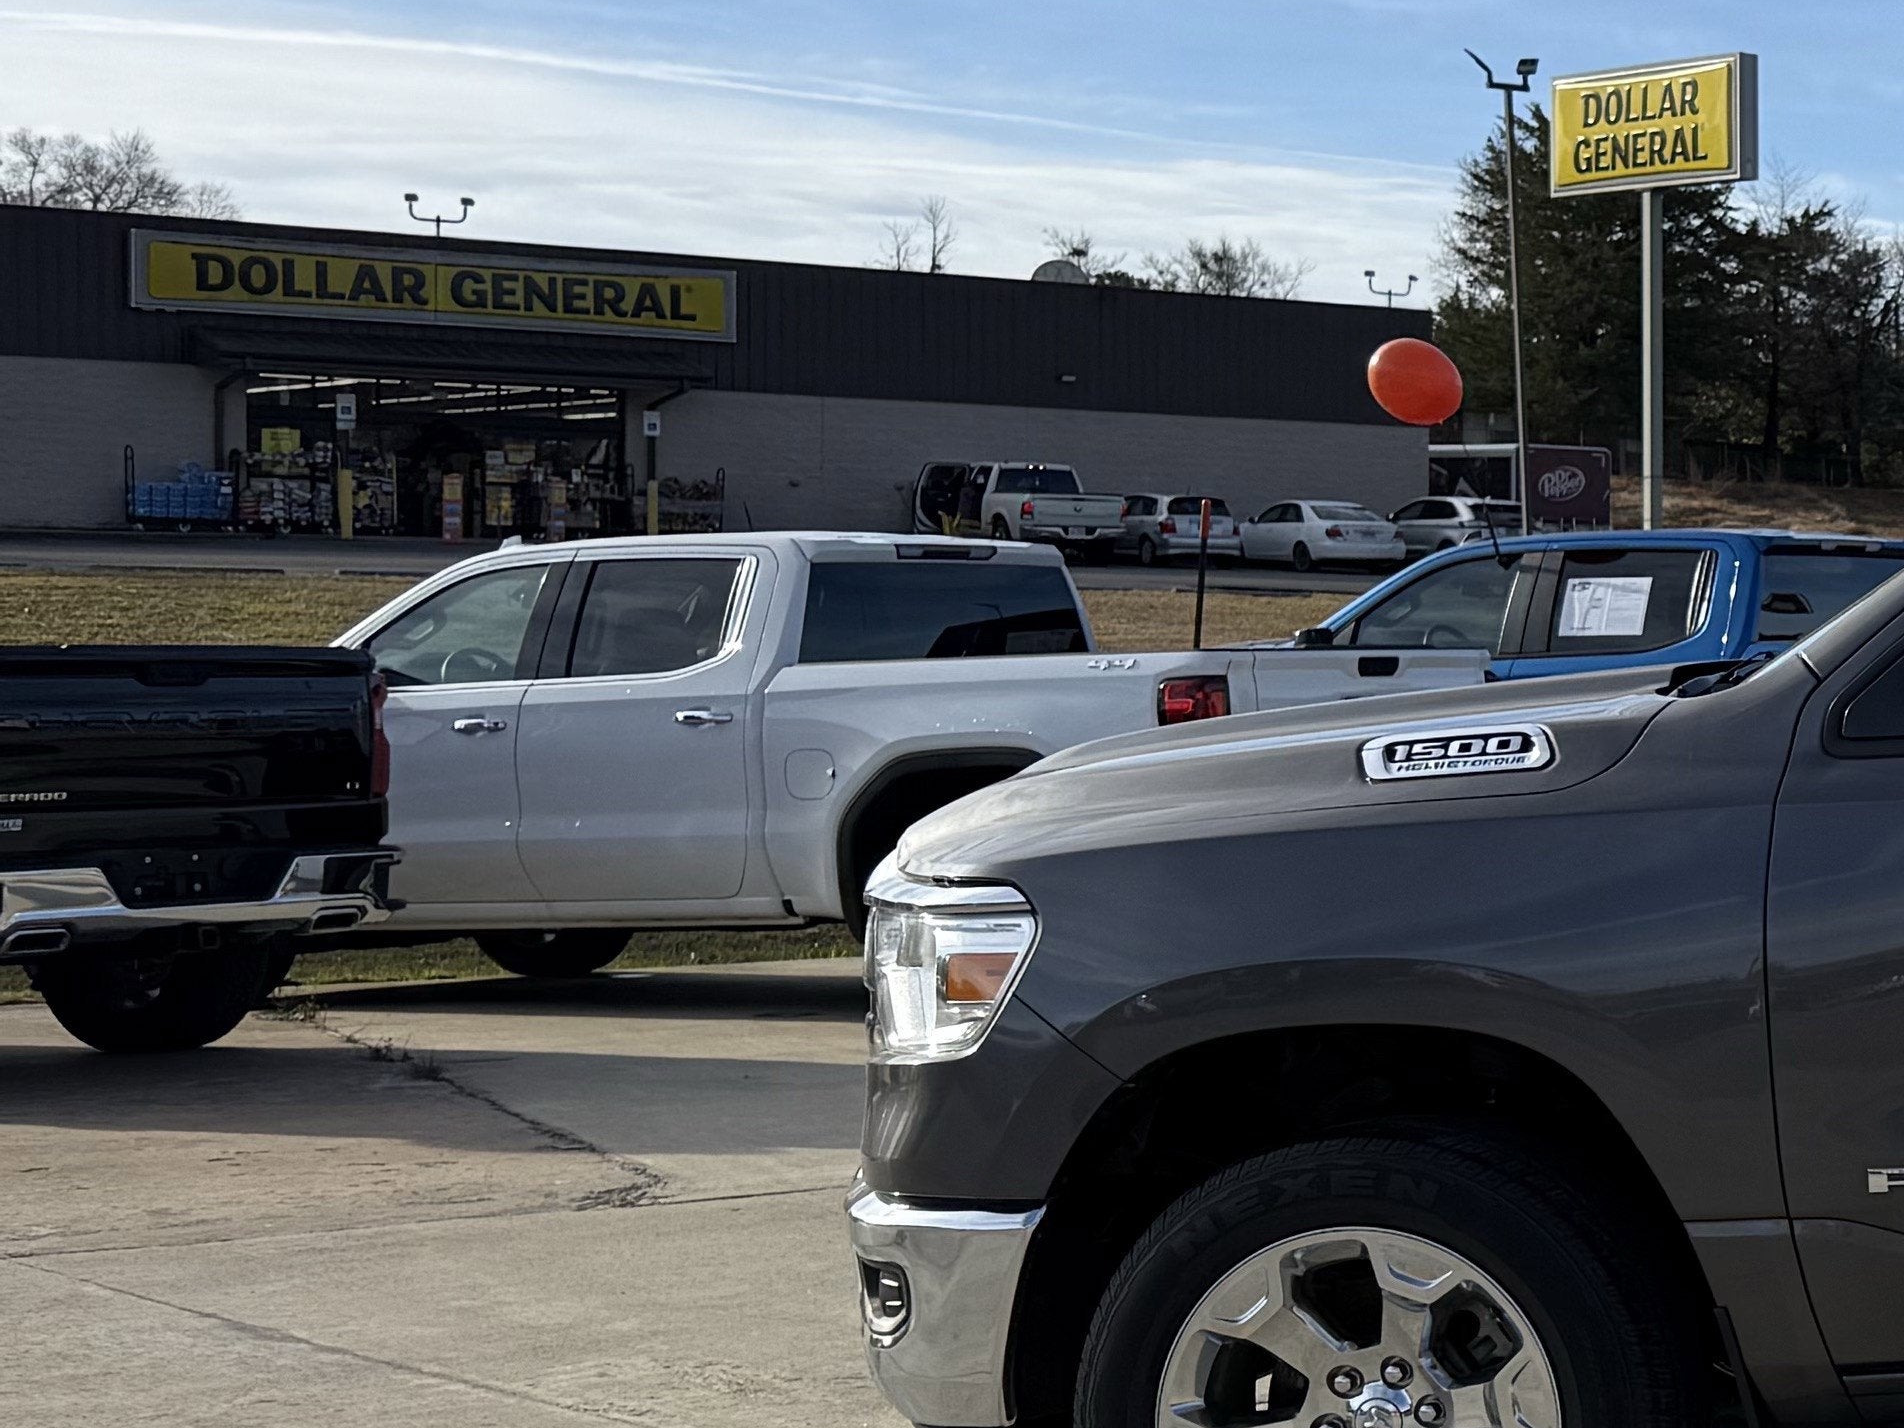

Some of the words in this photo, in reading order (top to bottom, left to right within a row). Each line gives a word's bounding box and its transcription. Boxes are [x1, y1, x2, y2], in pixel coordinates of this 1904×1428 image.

[1579, 77, 1699, 128] DOLLAR
[1573, 122, 1708, 174] GENERAL
[191, 252, 430, 307] DOLLAR
[450, 270, 697, 322] GENERAL
[1393, 735, 1523, 761] 1500
[1166, 1168, 1441, 1264] NEXEN
